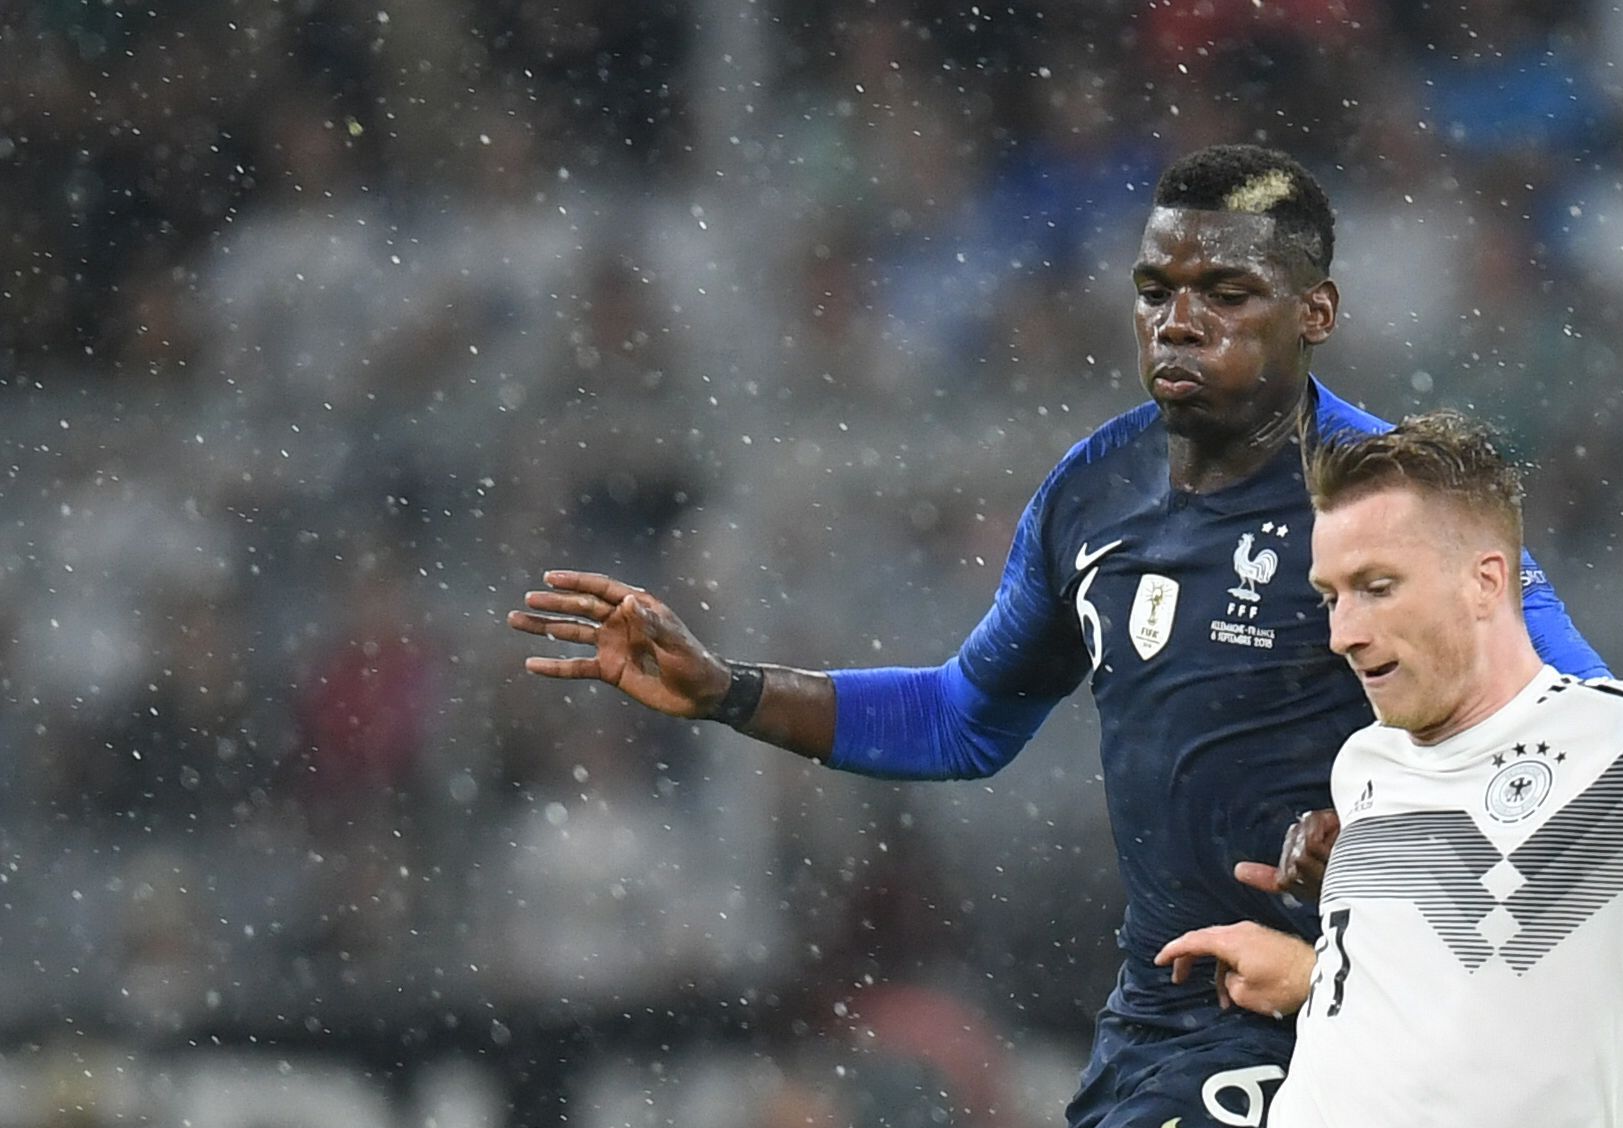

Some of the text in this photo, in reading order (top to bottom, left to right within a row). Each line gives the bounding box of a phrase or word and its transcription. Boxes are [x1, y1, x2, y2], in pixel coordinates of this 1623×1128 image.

[1076, 566, 1102, 671] 6
[1227, 602, 1258, 619] FFF
[1201, 1065, 1286, 1128] 6
